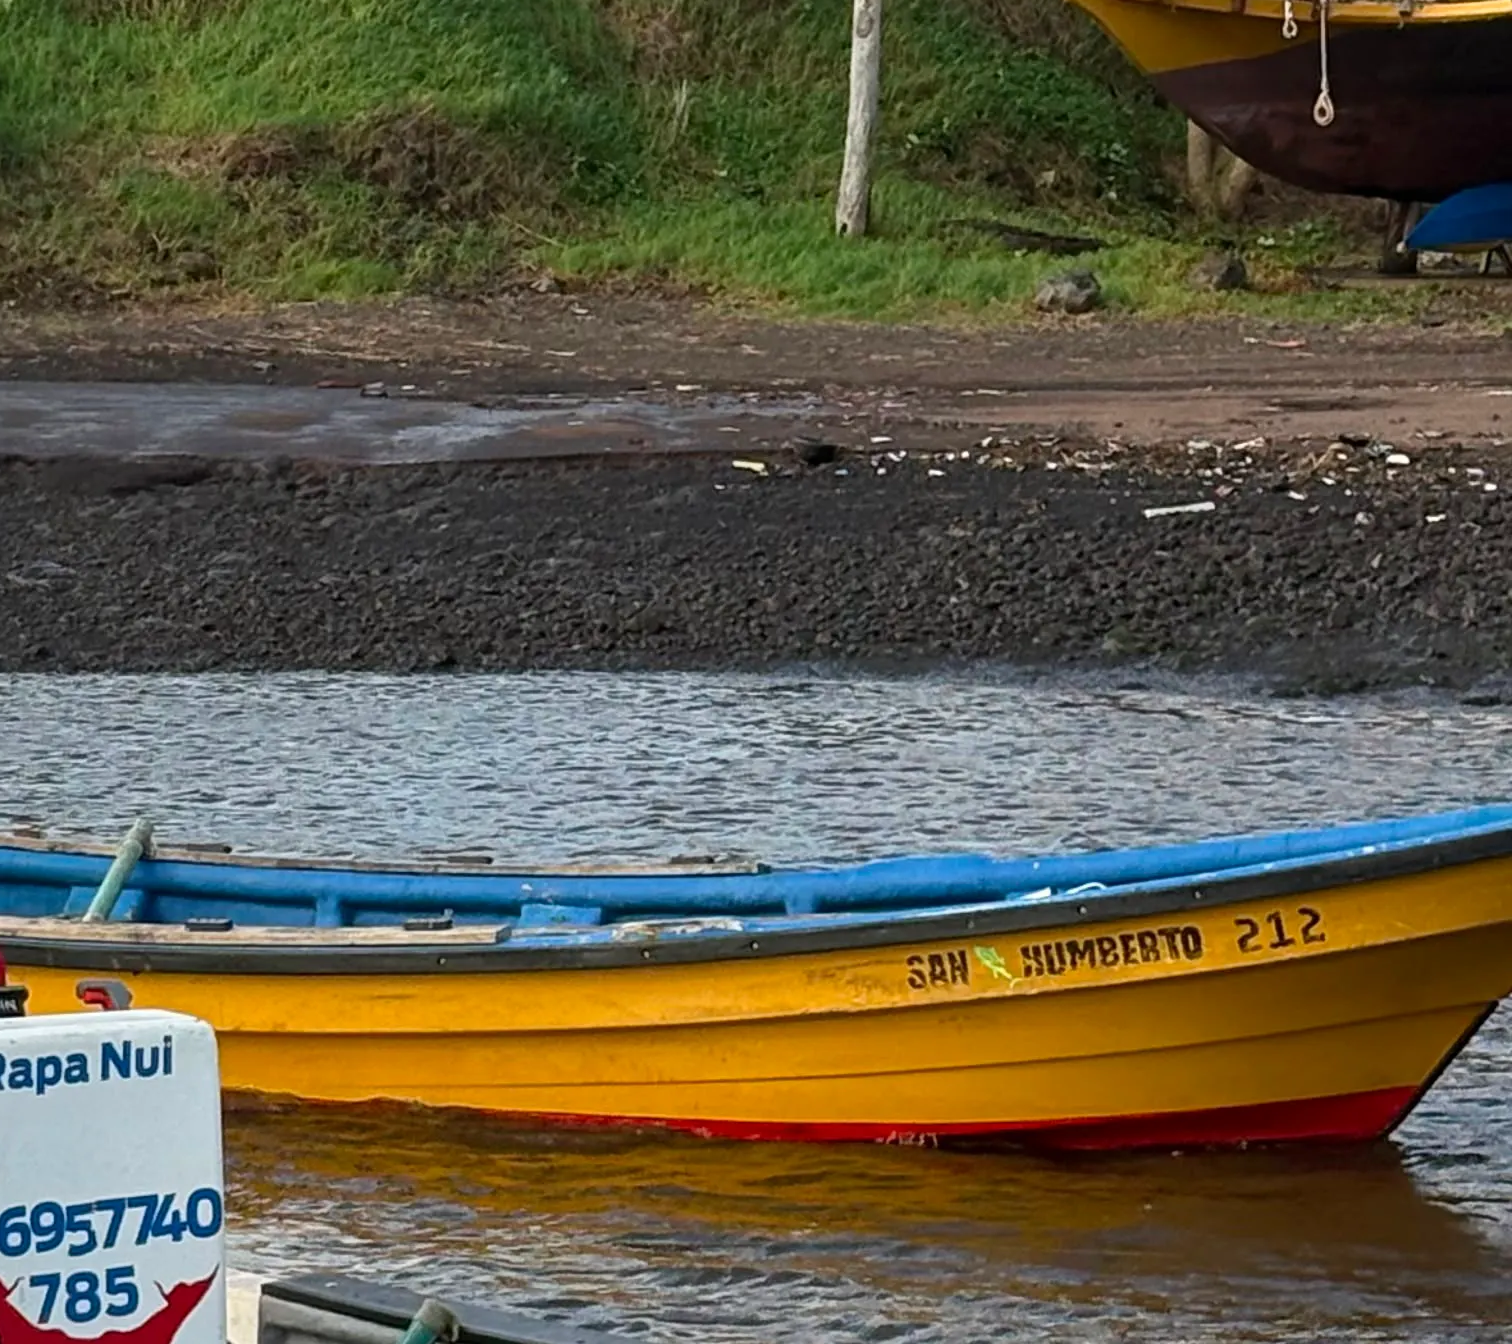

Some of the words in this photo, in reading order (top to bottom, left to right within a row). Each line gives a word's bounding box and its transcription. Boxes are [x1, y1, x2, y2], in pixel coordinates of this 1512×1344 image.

[906, 949, 970, 990] SAN
[1019, 925, 1203, 977] HUMBERTO
[1233, 906, 1326, 953] 212
[100, 1035, 174, 1081] Nui
[29, 1265, 140, 1325] 785
